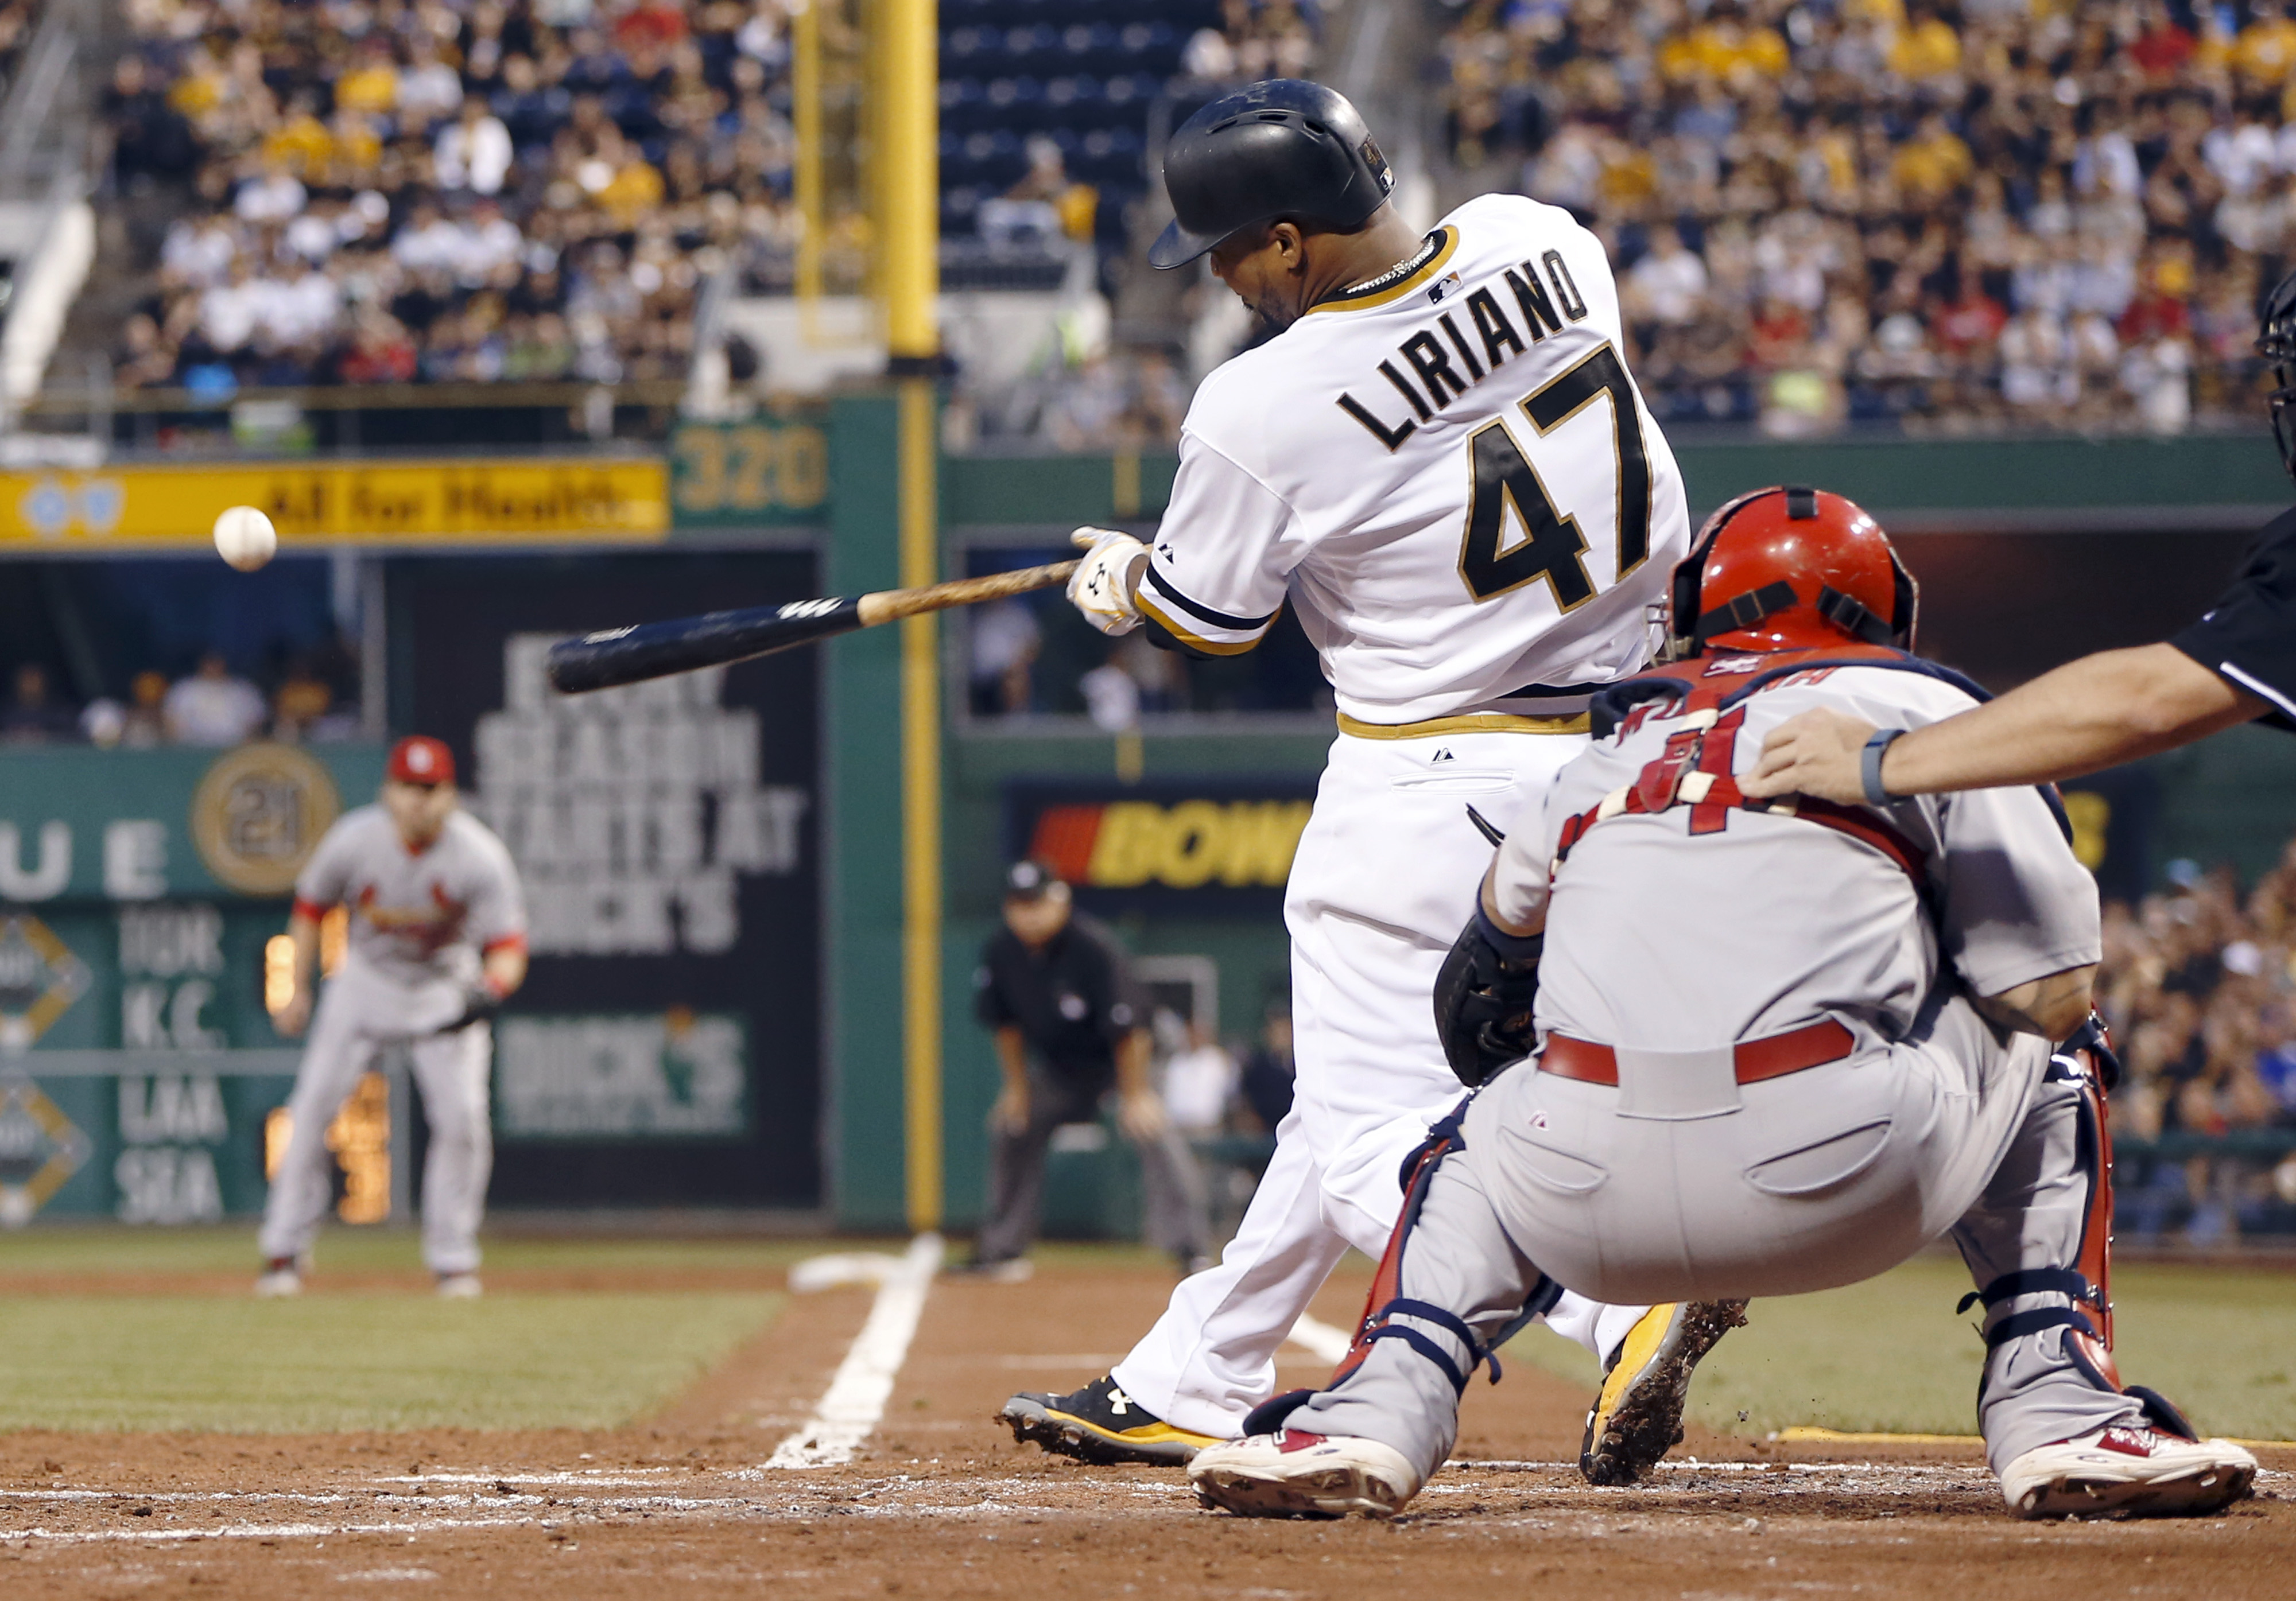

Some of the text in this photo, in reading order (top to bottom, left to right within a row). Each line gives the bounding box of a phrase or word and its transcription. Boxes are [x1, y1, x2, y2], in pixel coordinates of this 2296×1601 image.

[1335, 248, 1588, 454] LIRIANO
[672, 423, 828, 511] 320
[1457, 339, 1654, 616] 47
[228, 774, 305, 856] 21
